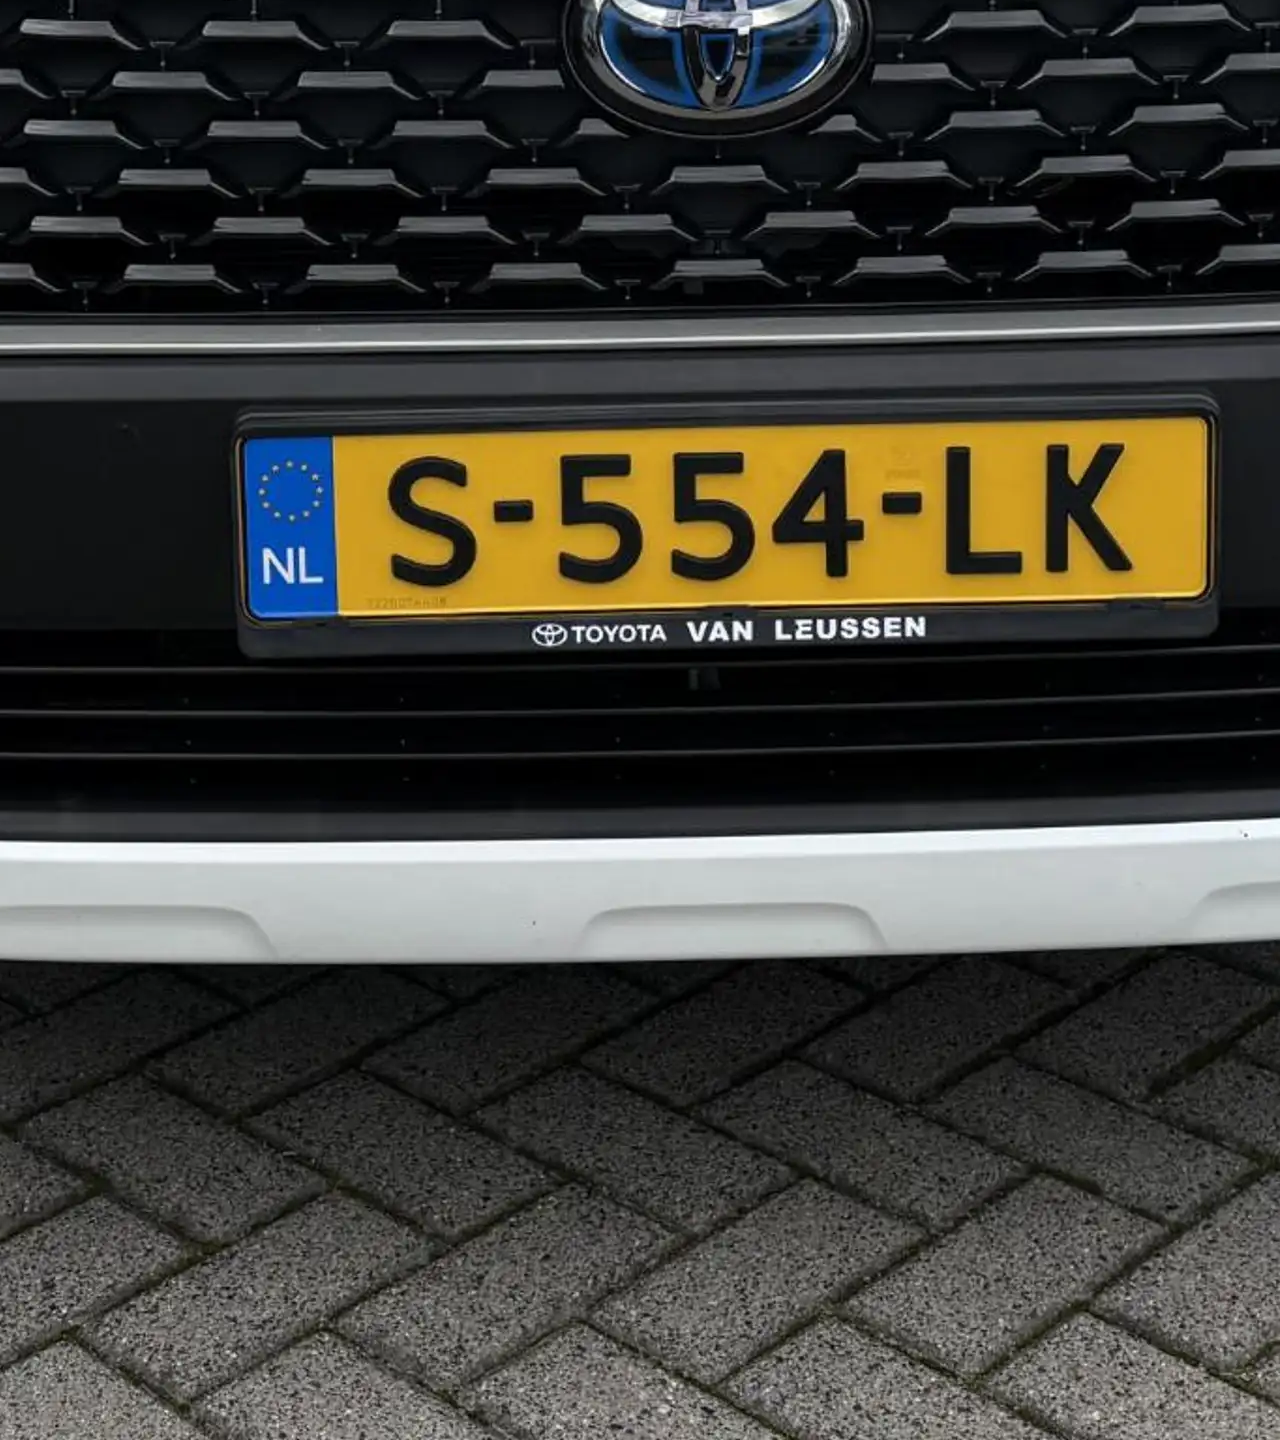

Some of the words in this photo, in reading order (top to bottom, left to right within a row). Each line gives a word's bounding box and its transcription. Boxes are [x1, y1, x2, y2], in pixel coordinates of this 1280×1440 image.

[387, 443, 1133, 588] S-554-LK
[261, 546, 325, 585] NL
[572, 623, 668, 645] TOYOTA
[686, 620, 754, 643] VAN
[774, 616, 927, 641] LEUSSEN
